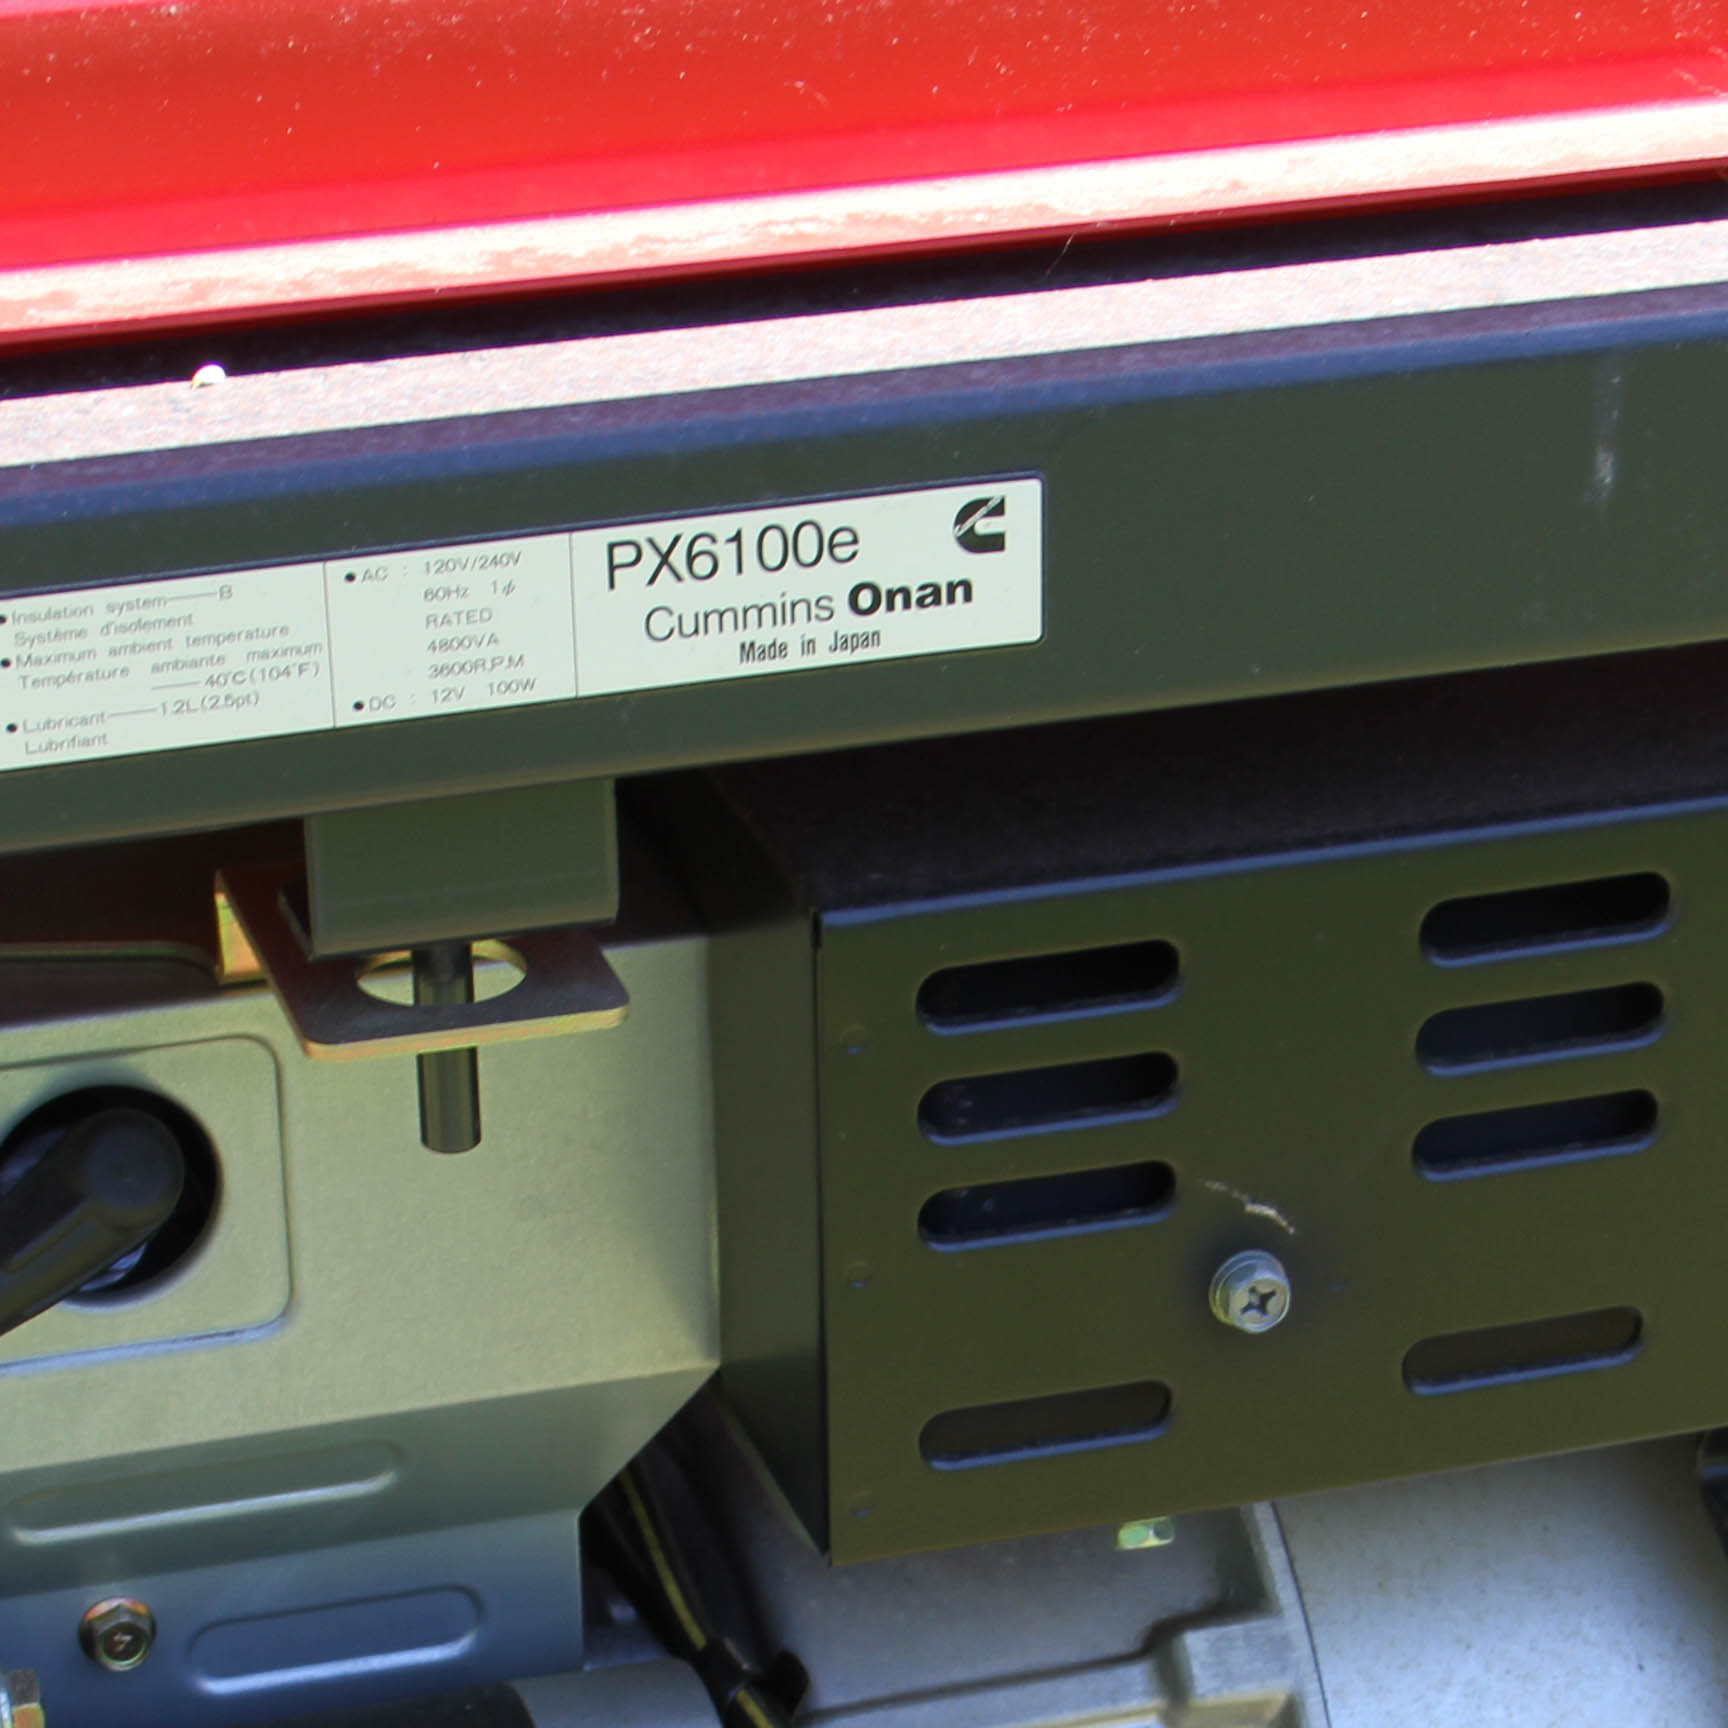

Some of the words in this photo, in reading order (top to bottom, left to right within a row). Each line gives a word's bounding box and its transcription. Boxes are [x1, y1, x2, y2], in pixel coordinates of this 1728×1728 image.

[607, 520, 857, 587] PX6100e
[645, 593, 833, 641] Cummins
[848, 579, 972, 616] Onan
[739, 638, 787, 663] Made
[800, 633, 816, 656] in
[828, 629, 880, 653] Japan
